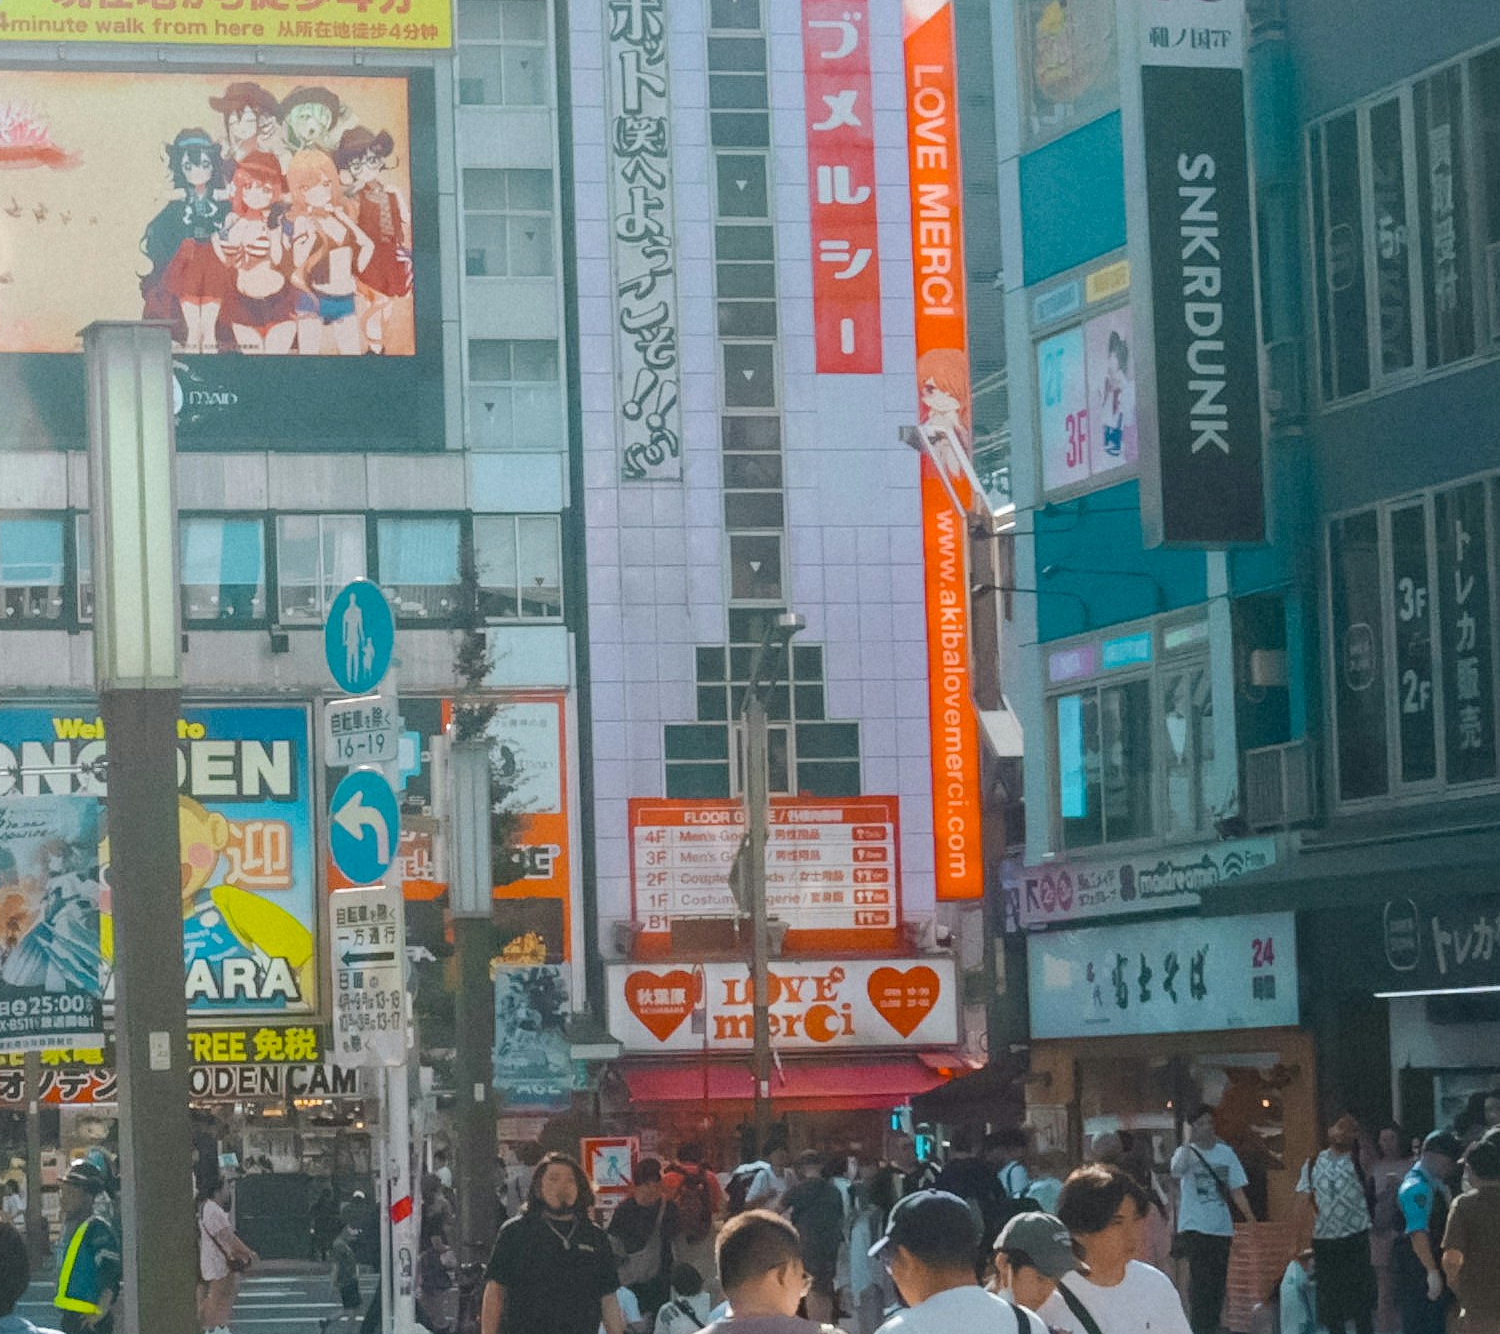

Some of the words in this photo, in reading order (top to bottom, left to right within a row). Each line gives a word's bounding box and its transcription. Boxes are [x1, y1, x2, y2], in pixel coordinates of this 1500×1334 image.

[95, 17, 146, 36] walk
[153, 18, 207, 37] from
[216, 19, 265, 38] here
[913, 65, 947, 169] LOVE
[918, 184, 954, 315] MERCI
[1177, 154, 1230, 455] SNKRDUNK
[1065, 409, 1088, 468] 3F
[935, 510, 970, 879] www.akibalovemerci.com
[331, 707, 391, 734] 自転車を除く
[336, 734, 385, 758] 16-19
[684, 812, 730, 823] FLOOR
[645, 827, 667, 843] 4F
[226, 824, 290, 886] 迎
[646, 850, 667, 866] 3F
[647, 873, 668, 887] 2F
[650, 893, 669, 908] 1F
[681, 893, 738, 906] Costum
[338, 927, 396, 946] 一方通行
[1252, 938, 1275, 967] 24
[253, 1027, 318, 1061] 免税
[190, 1067, 283, 1097] ODEN
